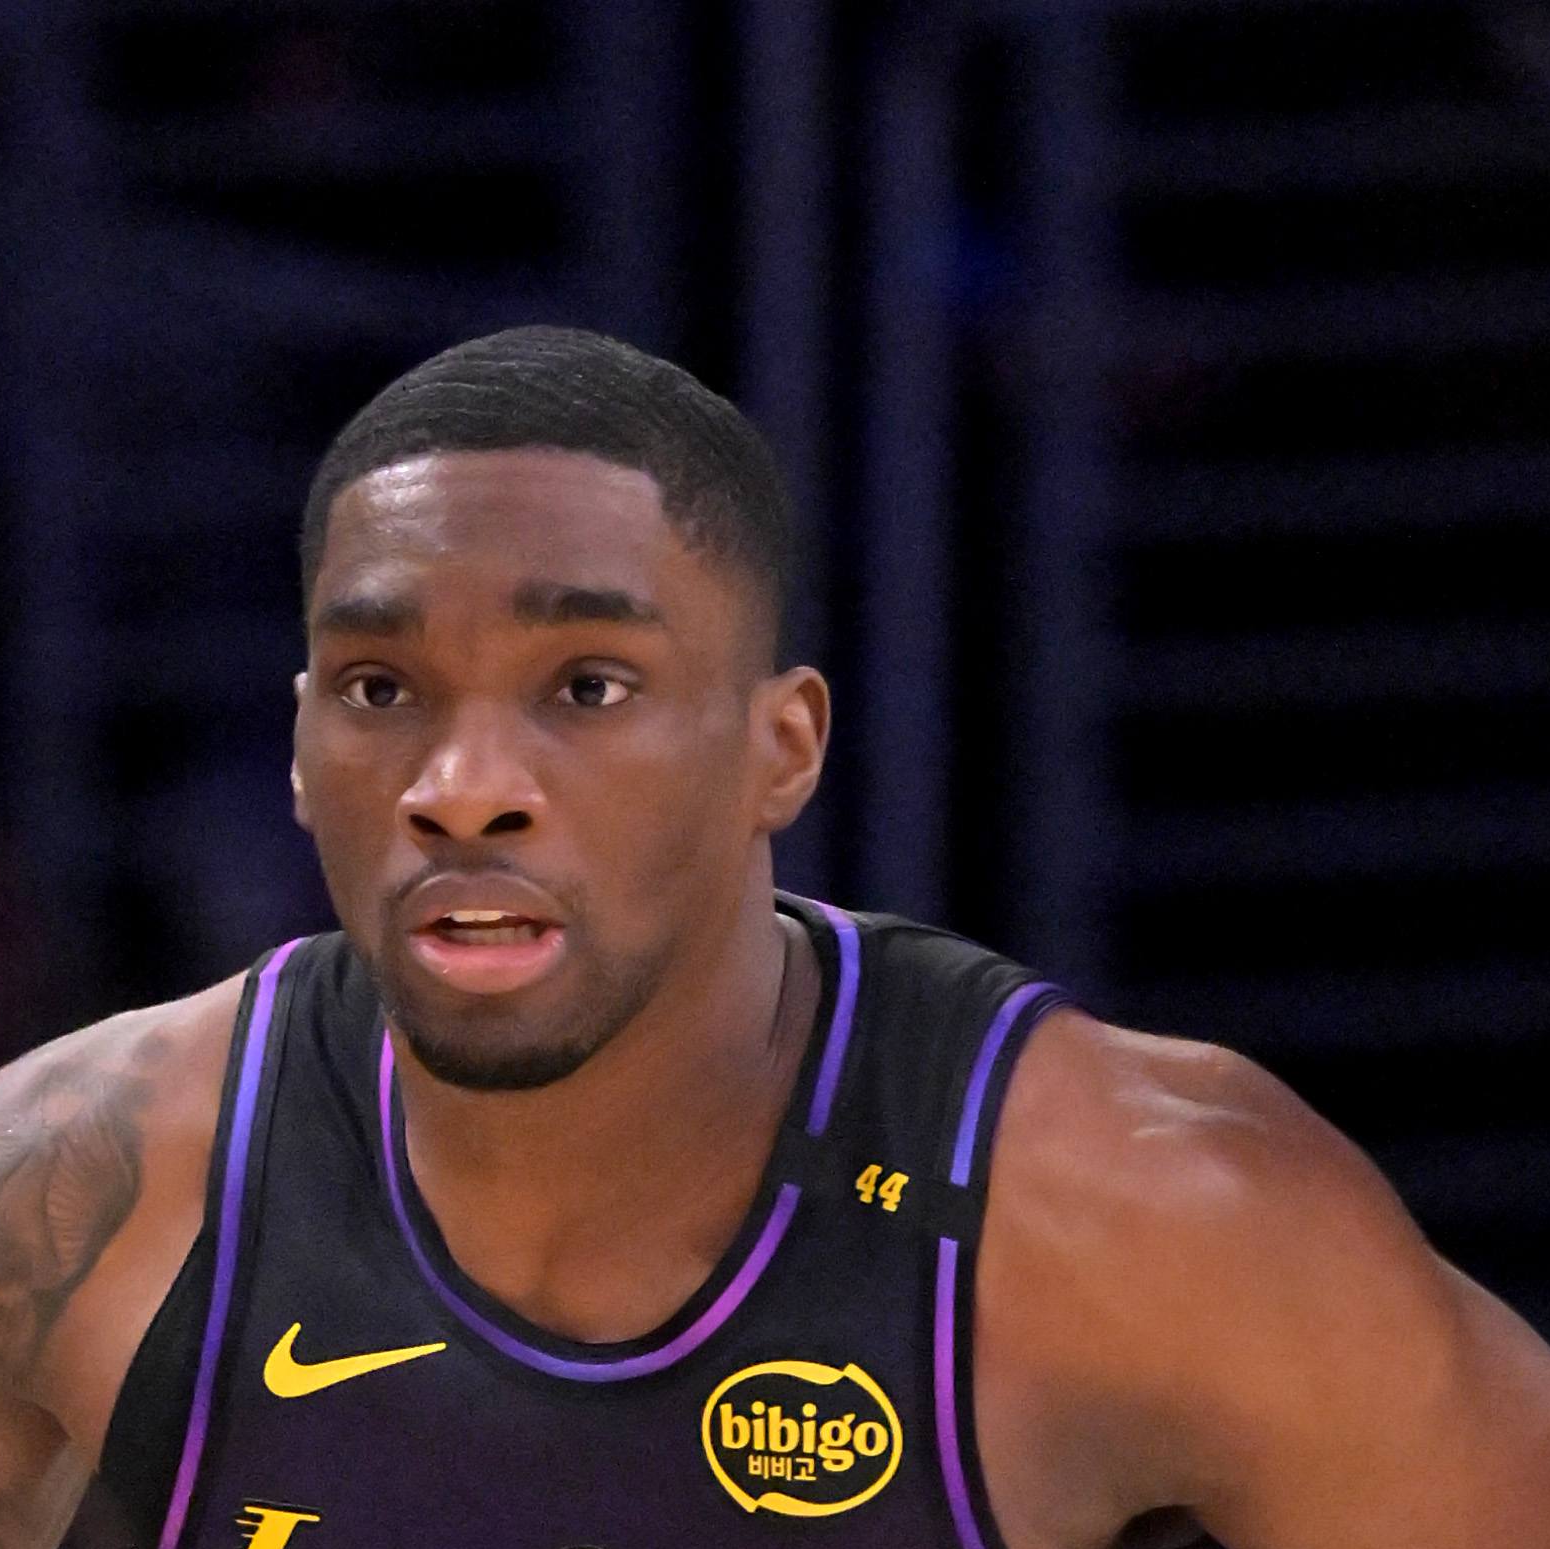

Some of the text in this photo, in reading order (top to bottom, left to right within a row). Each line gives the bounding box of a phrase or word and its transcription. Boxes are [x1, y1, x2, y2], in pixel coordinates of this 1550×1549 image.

[855, 1163, 910, 1212] 44
[719, 1400, 889, 1472] bibigo
[747, 1454, 817, 1482] 비비고
